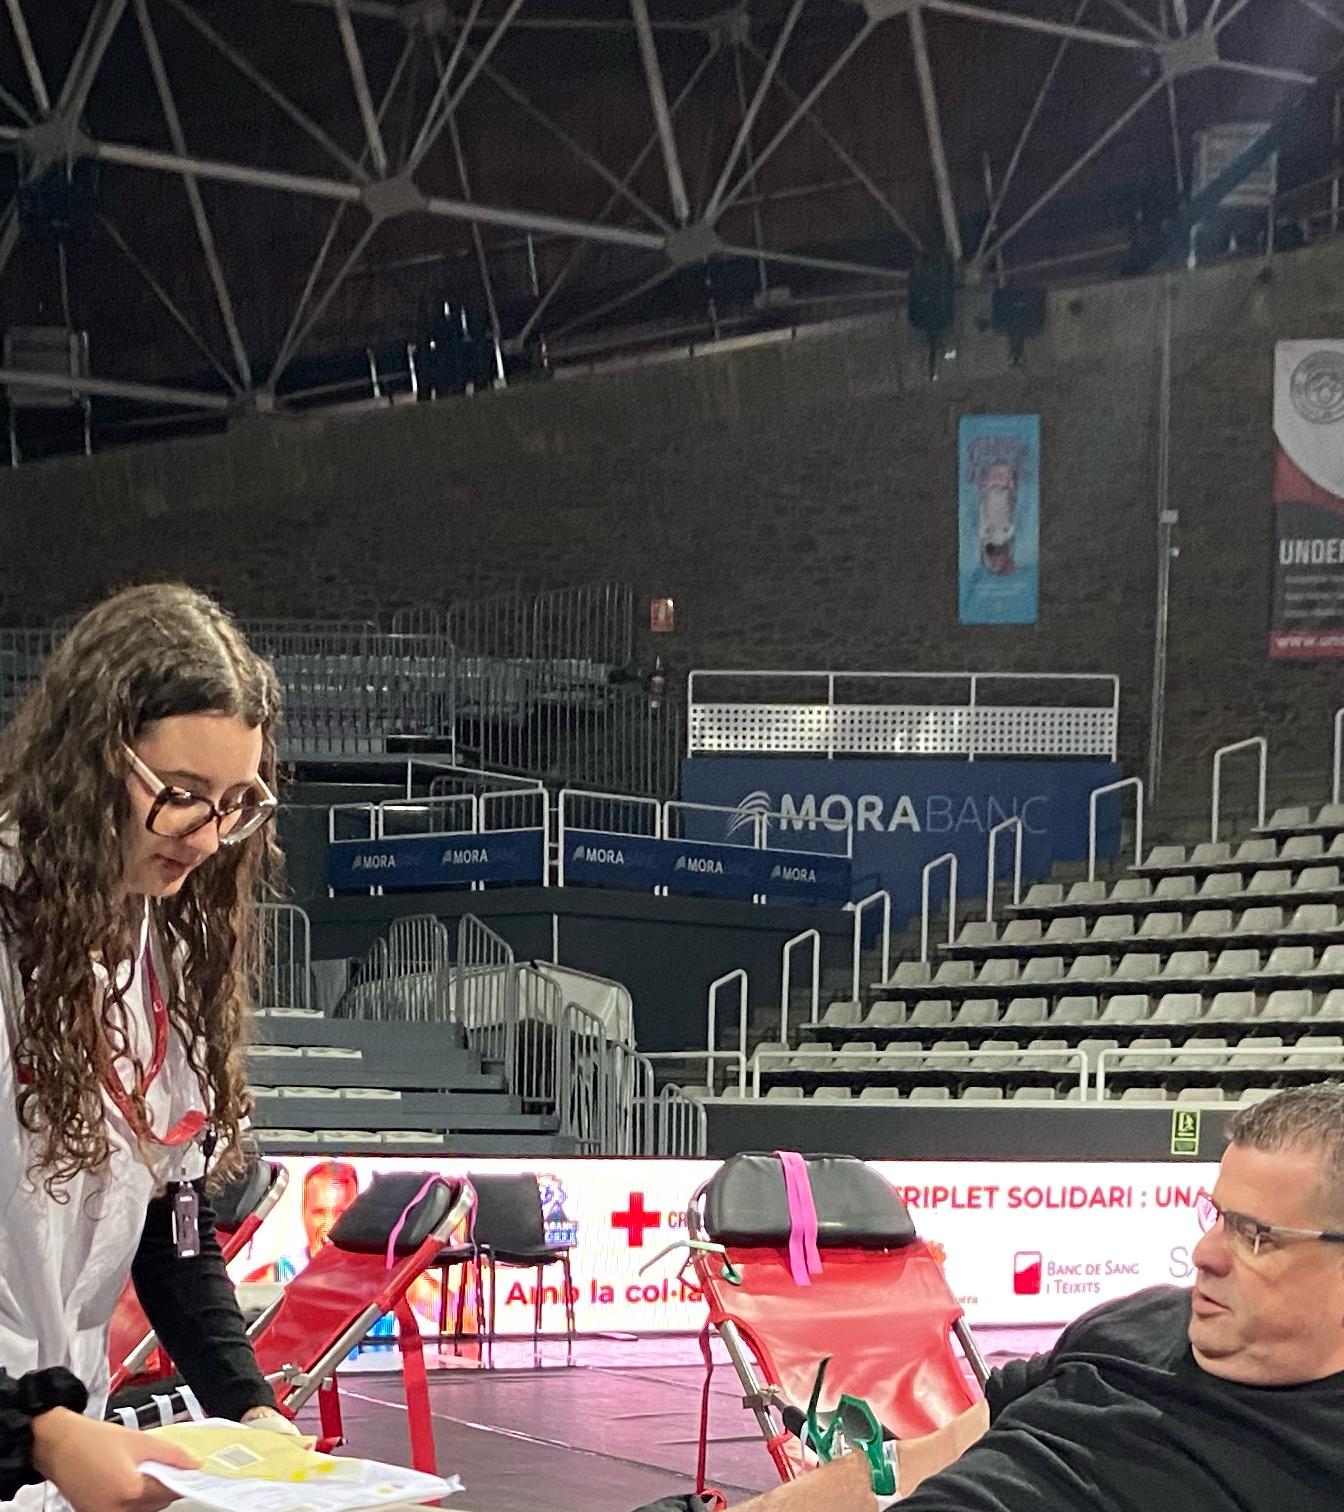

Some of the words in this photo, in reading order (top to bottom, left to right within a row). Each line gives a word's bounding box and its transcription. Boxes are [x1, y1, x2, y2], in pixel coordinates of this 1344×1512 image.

[779, 794, 1050, 834] MORABANC
[1007, 1186, 1133, 1210] SOLIDARI
[506, 1281, 580, 1305] Amb
[590, 1279, 615, 1304] la
